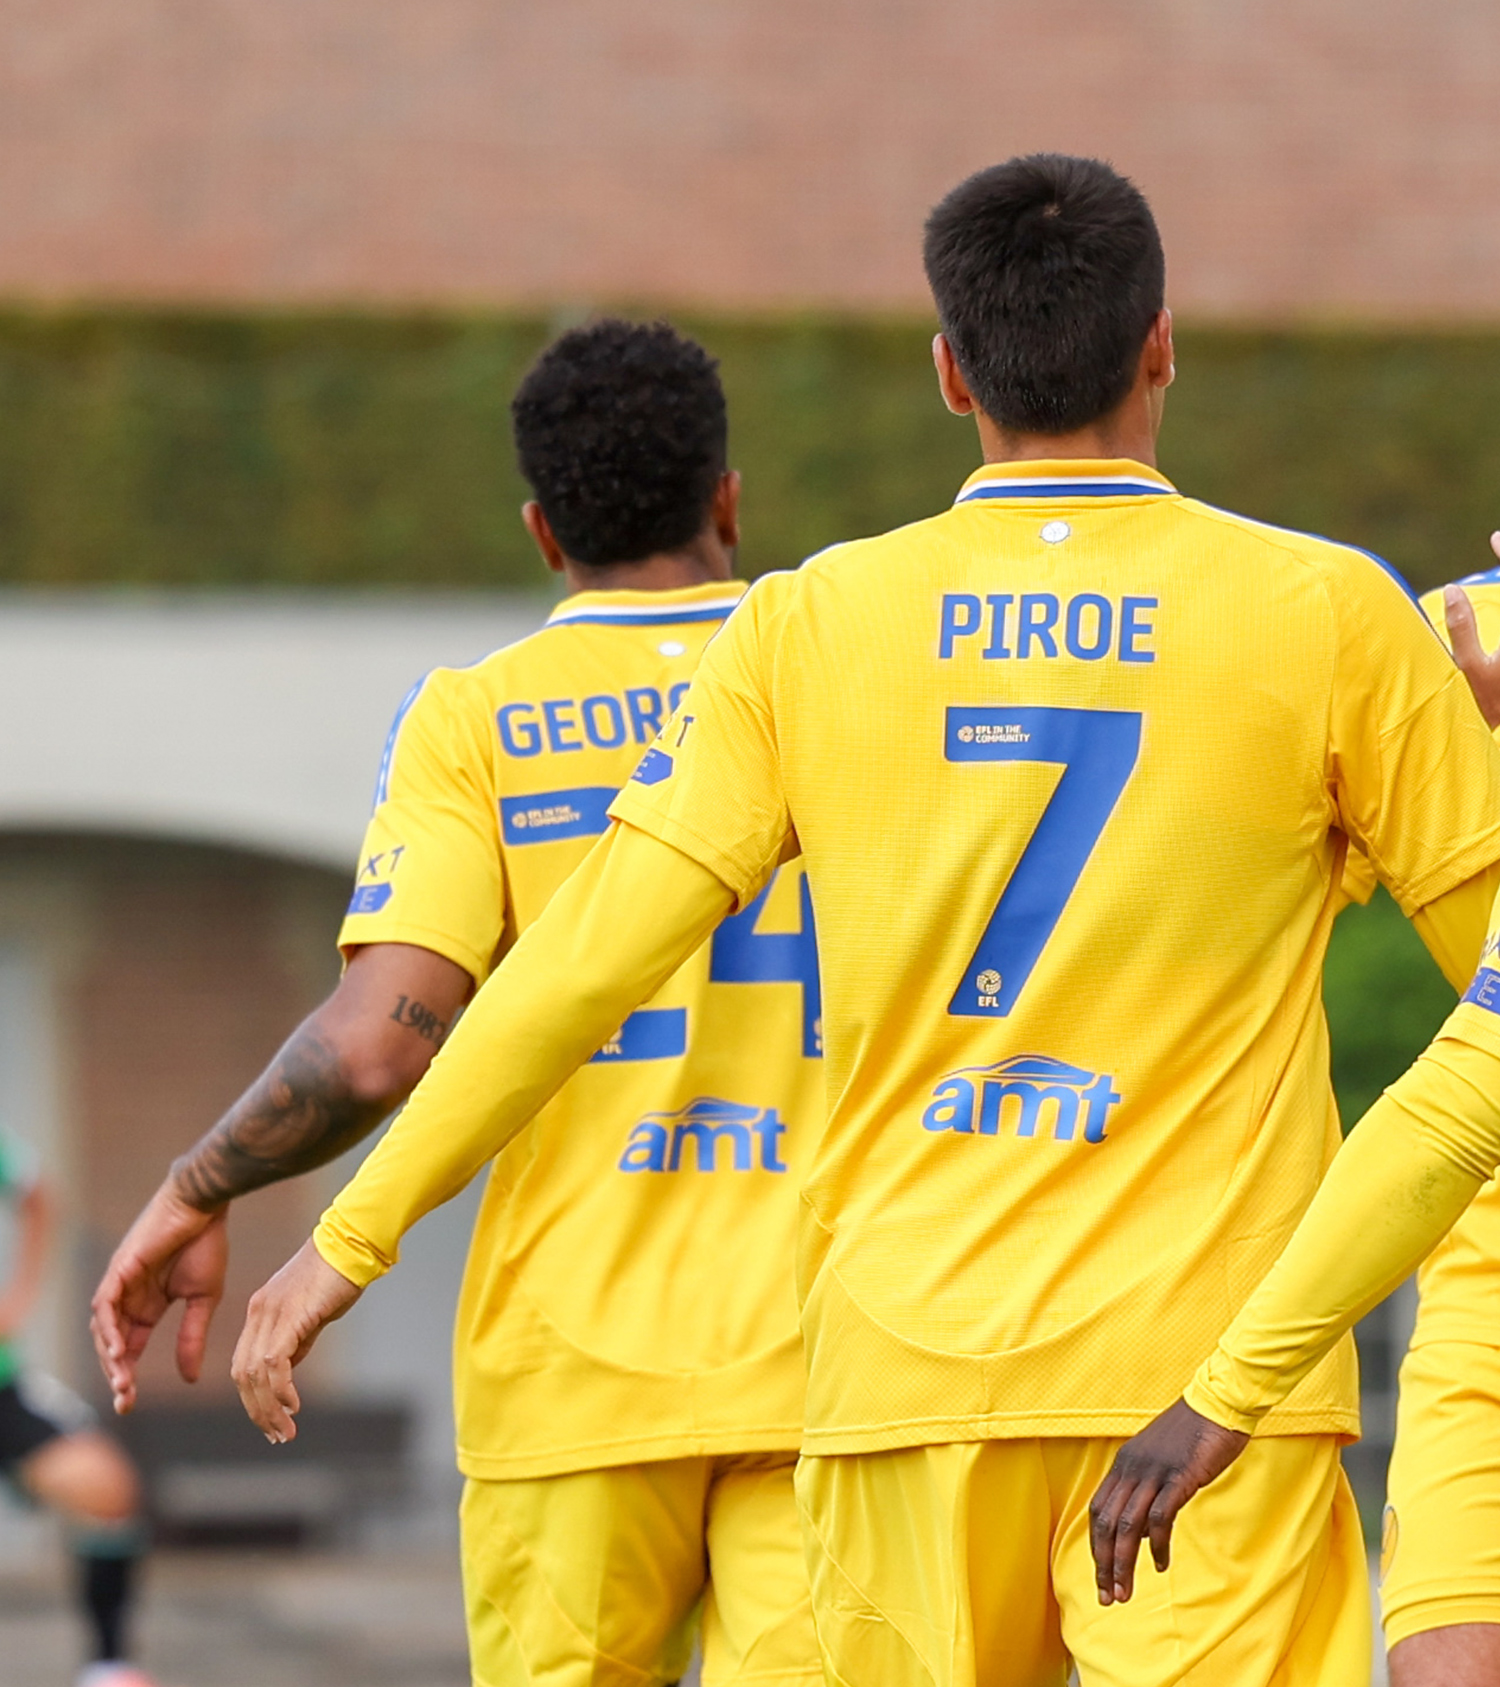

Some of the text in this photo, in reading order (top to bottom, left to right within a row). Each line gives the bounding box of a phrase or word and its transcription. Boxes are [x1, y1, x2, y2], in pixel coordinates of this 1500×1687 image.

[939, 592, 1159, 663] PIROE
[975, 724, 1022, 734] EFL IN THE
[975, 733, 1031, 744] COMMUNITY
[945, 706, 1143, 1018] 7
[977, 995, 1000, 1008] EFL
[921, 1062, 1122, 1144] amt
[618, 1104, 788, 1173] amt
